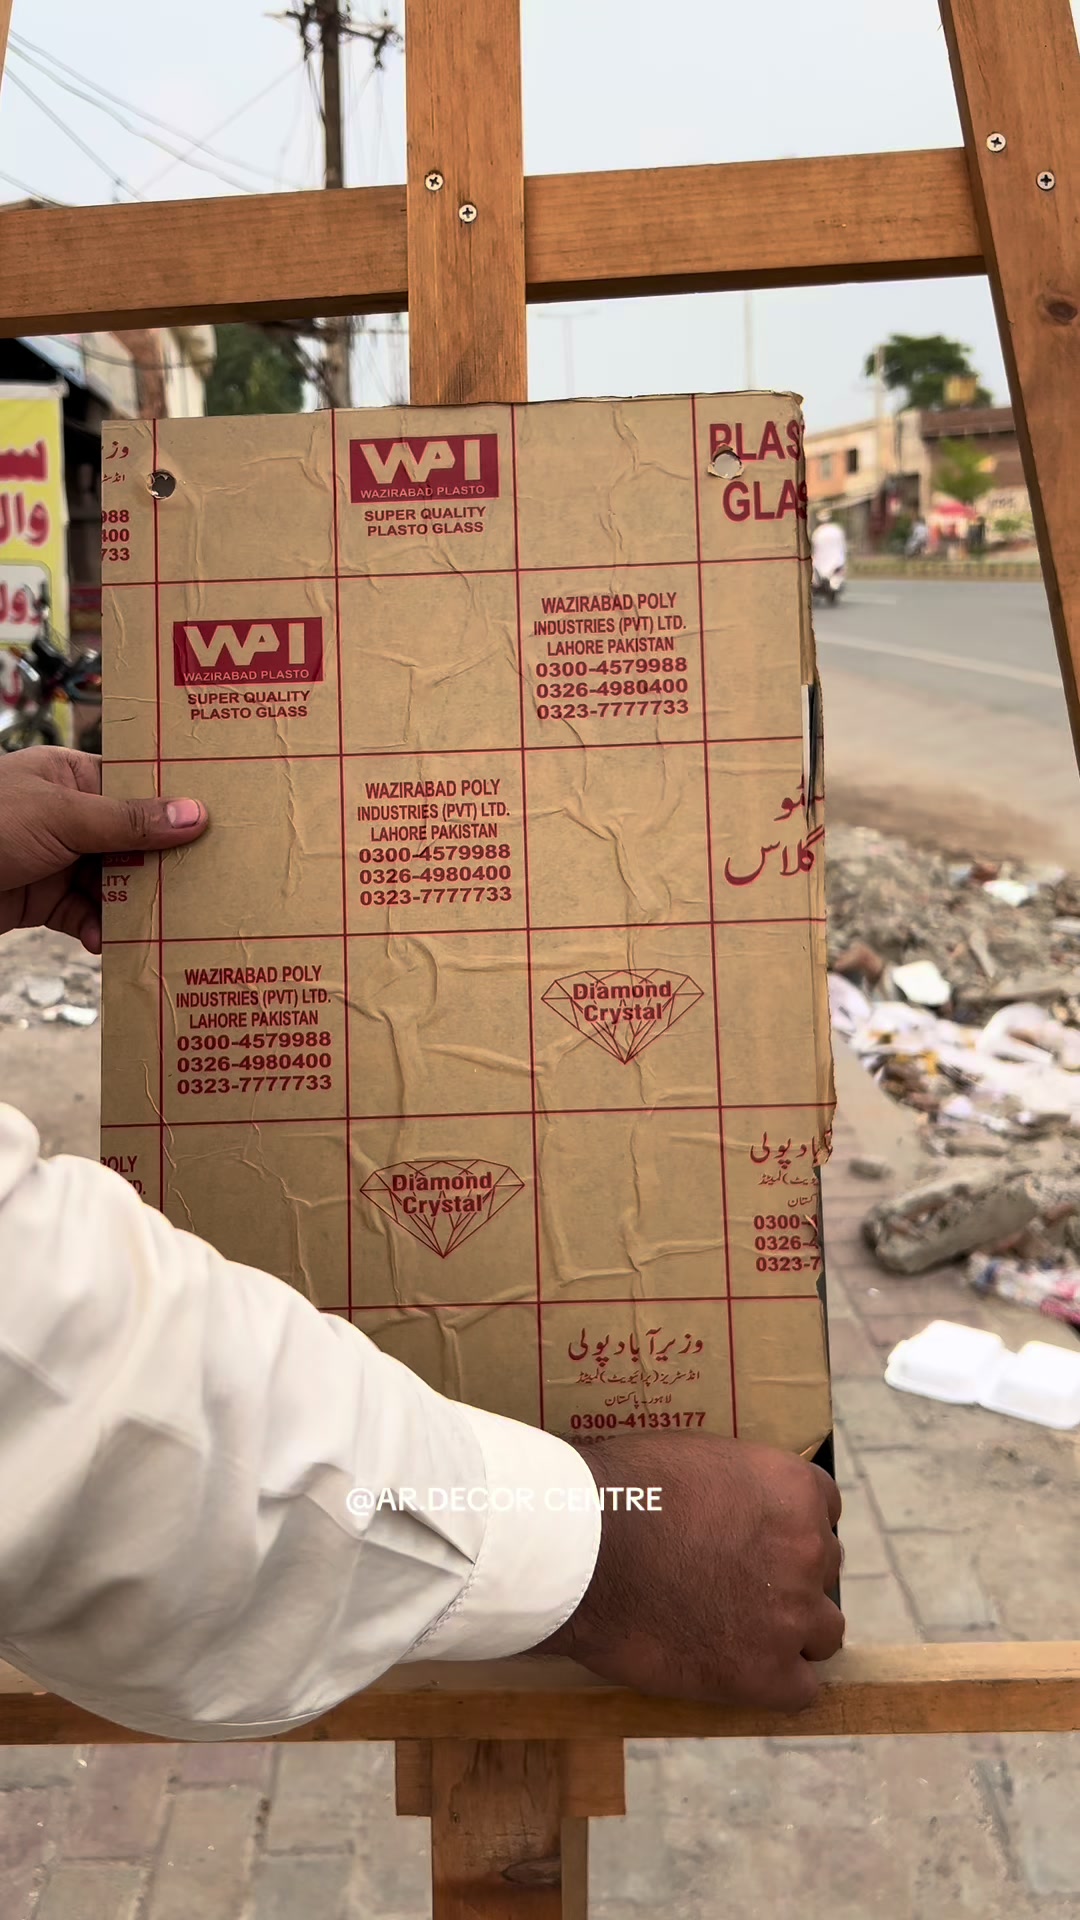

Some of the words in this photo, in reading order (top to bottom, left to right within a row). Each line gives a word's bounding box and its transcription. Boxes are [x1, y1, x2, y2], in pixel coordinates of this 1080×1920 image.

[360, 487, 433, 499] WAZIRABAD
[437, 485, 485, 496] PLASTO
[364, 509, 416, 522] SUPER
[420, 506, 486, 520] QUALITY
[367, 524, 428, 537] PLASTO
[432, 521, 484, 534] GLASS
[541, 594, 633, 614] WAZIRABAD
[638, 592, 677, 609] POLY
[534, 618, 615, 636] INDUSTRIES
[619, 616, 654, 635] (PVT)
[658, 615, 687, 630] LTD.
[547, 639, 604, 656] LAHORE
[608, 637, 674, 653] PAKISTAN
[183, 670, 257, 682] WAZIRABAD
[261, 669, 310, 680] PLASTO
[536, 657, 687, 677] 0300-4579988
[188, 693, 240, 705] SUPER
[243, 690, 310, 703] QUALITY
[536, 678, 688, 698] 0326-4980400
[190, 707, 251, 720] PLASTO
[256, 705, 308, 718] GLASS
[537, 699, 689, 719] 0323-7777733
[365, 780, 457, 799] WAZIRABAD
[461, 778, 501, 796] POLY
[357, 804, 438, 821] INDUSTRIES
[442, 803, 477, 822] (PVT)
[481, 802, 510, 817] LTD.
[371, 825, 427, 842] LAHORE
[431, 823, 498, 840] PAKISTAN
[359, 844, 511, 863] 0300-4579988
[359, 865, 511, 884] 0326-4980400
[360, 886, 512, 906] 0323-7777733
[185, 966, 278, 986] WAZIRABAD
[282, 965, 322, 982] POLY
[176, 991, 259, 1008] INDUSTRIES
[262, 989, 298, 1008] (PVT)
[302, 988, 331, 1004] LTD.
[573, 981, 672, 1001] Diamond
[189, 1012, 247, 1029] LAHORE
[251, 1010, 318, 1027] PAKISTAN
[583, 1003, 662, 1024] Crystal
[177, 1031, 331, 1051] 0300-4579988
[177, 1053, 332, 1073] 0326-4980400
[177, 1075, 332, 1095] 0323-7777733
[392, 1172, 492, 1192] Diamond
[402, 1194, 482, 1217] Crystal
[756, 1255, 821, 1272] 0323-7
[570, 1411, 706, 1430] 0300-4133177
